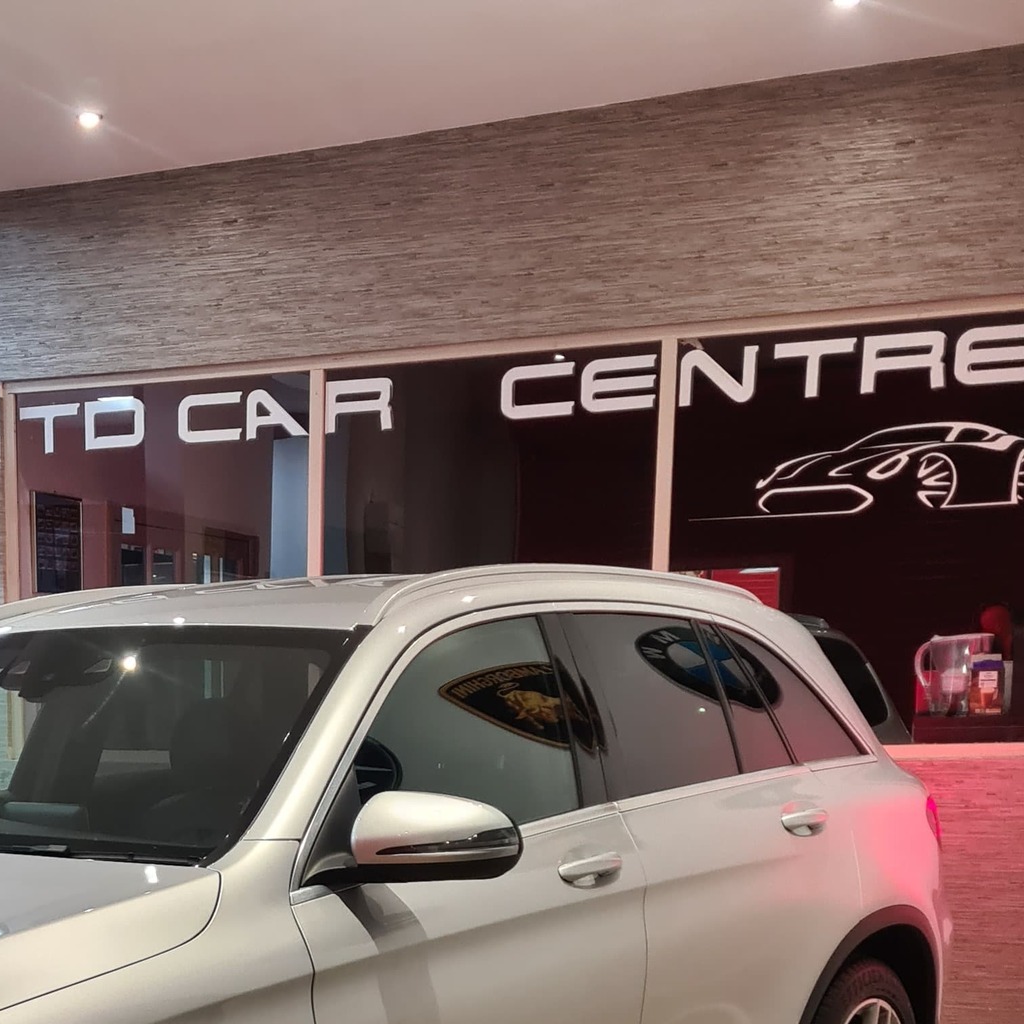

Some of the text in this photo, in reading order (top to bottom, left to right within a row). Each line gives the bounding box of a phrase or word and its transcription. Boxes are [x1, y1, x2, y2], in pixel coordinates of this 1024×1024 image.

[19, 323, 1024, 454] TD CAR CENTRE
